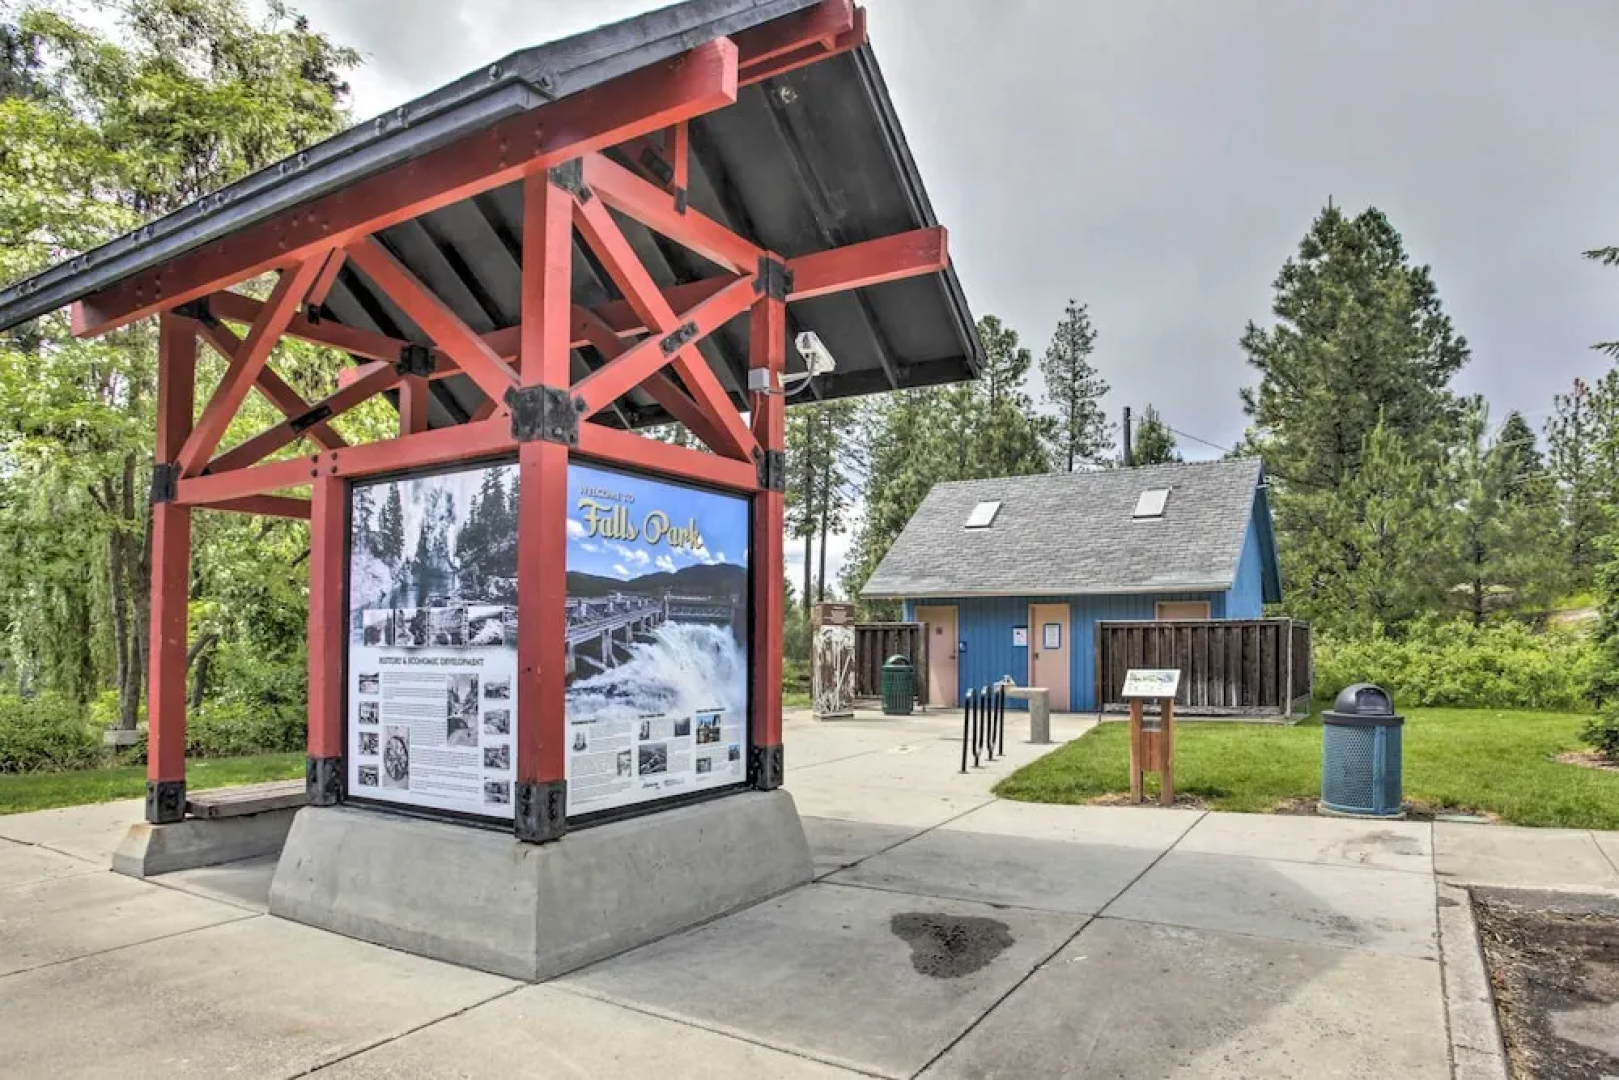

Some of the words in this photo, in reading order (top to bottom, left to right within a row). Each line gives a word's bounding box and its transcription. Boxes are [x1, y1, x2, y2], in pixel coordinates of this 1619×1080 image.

[580, 485, 622, 502] WELCOME
[624, 493, 635, 503] TO
[578, 498, 639, 541] Falls
[644, 508, 704, 549] Park
[440, 657, 484, 667] DEVELOPMENT
